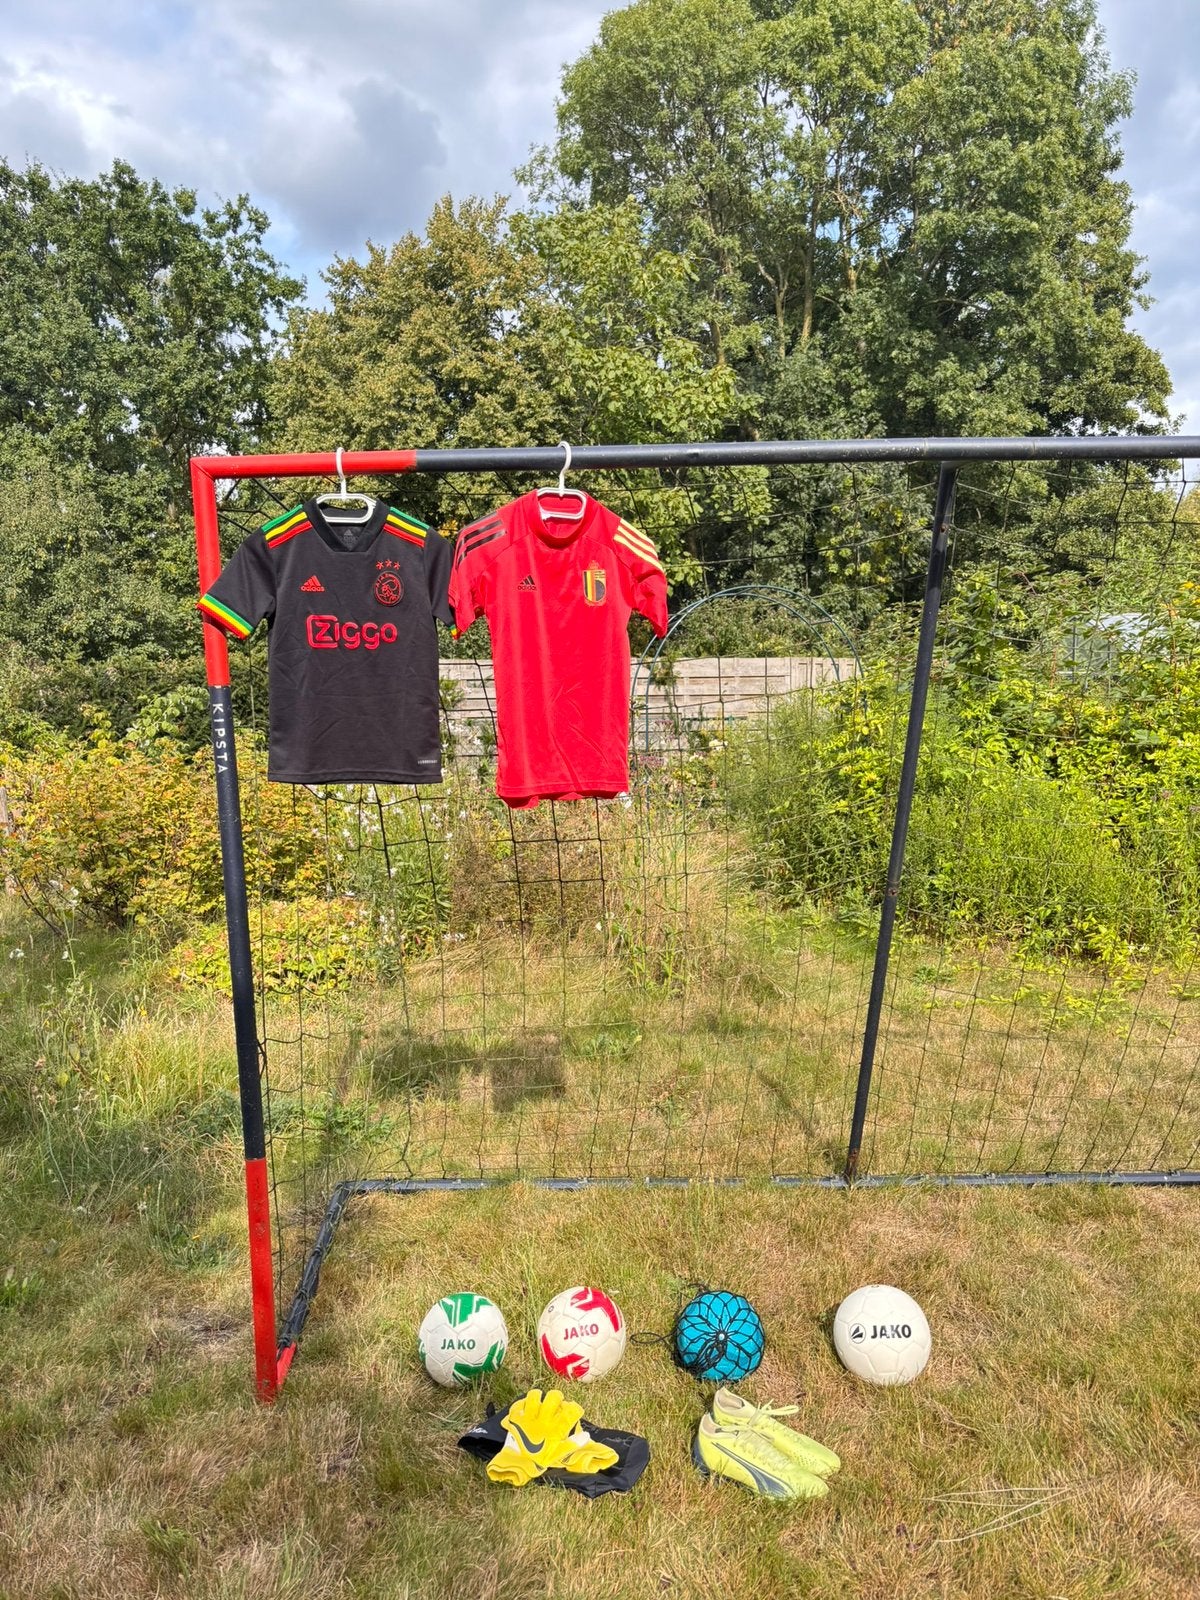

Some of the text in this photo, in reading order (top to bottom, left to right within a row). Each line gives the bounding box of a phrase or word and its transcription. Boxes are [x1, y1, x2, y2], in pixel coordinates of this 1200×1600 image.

[313, 620, 398, 650] Ziggo
[212, 703, 229, 773] KIPSTA
[562, 1323, 599, 1340] JAKO
[870, 1324, 912, 1339] JAKO
[441, 1338, 476, 1350] JAKO
